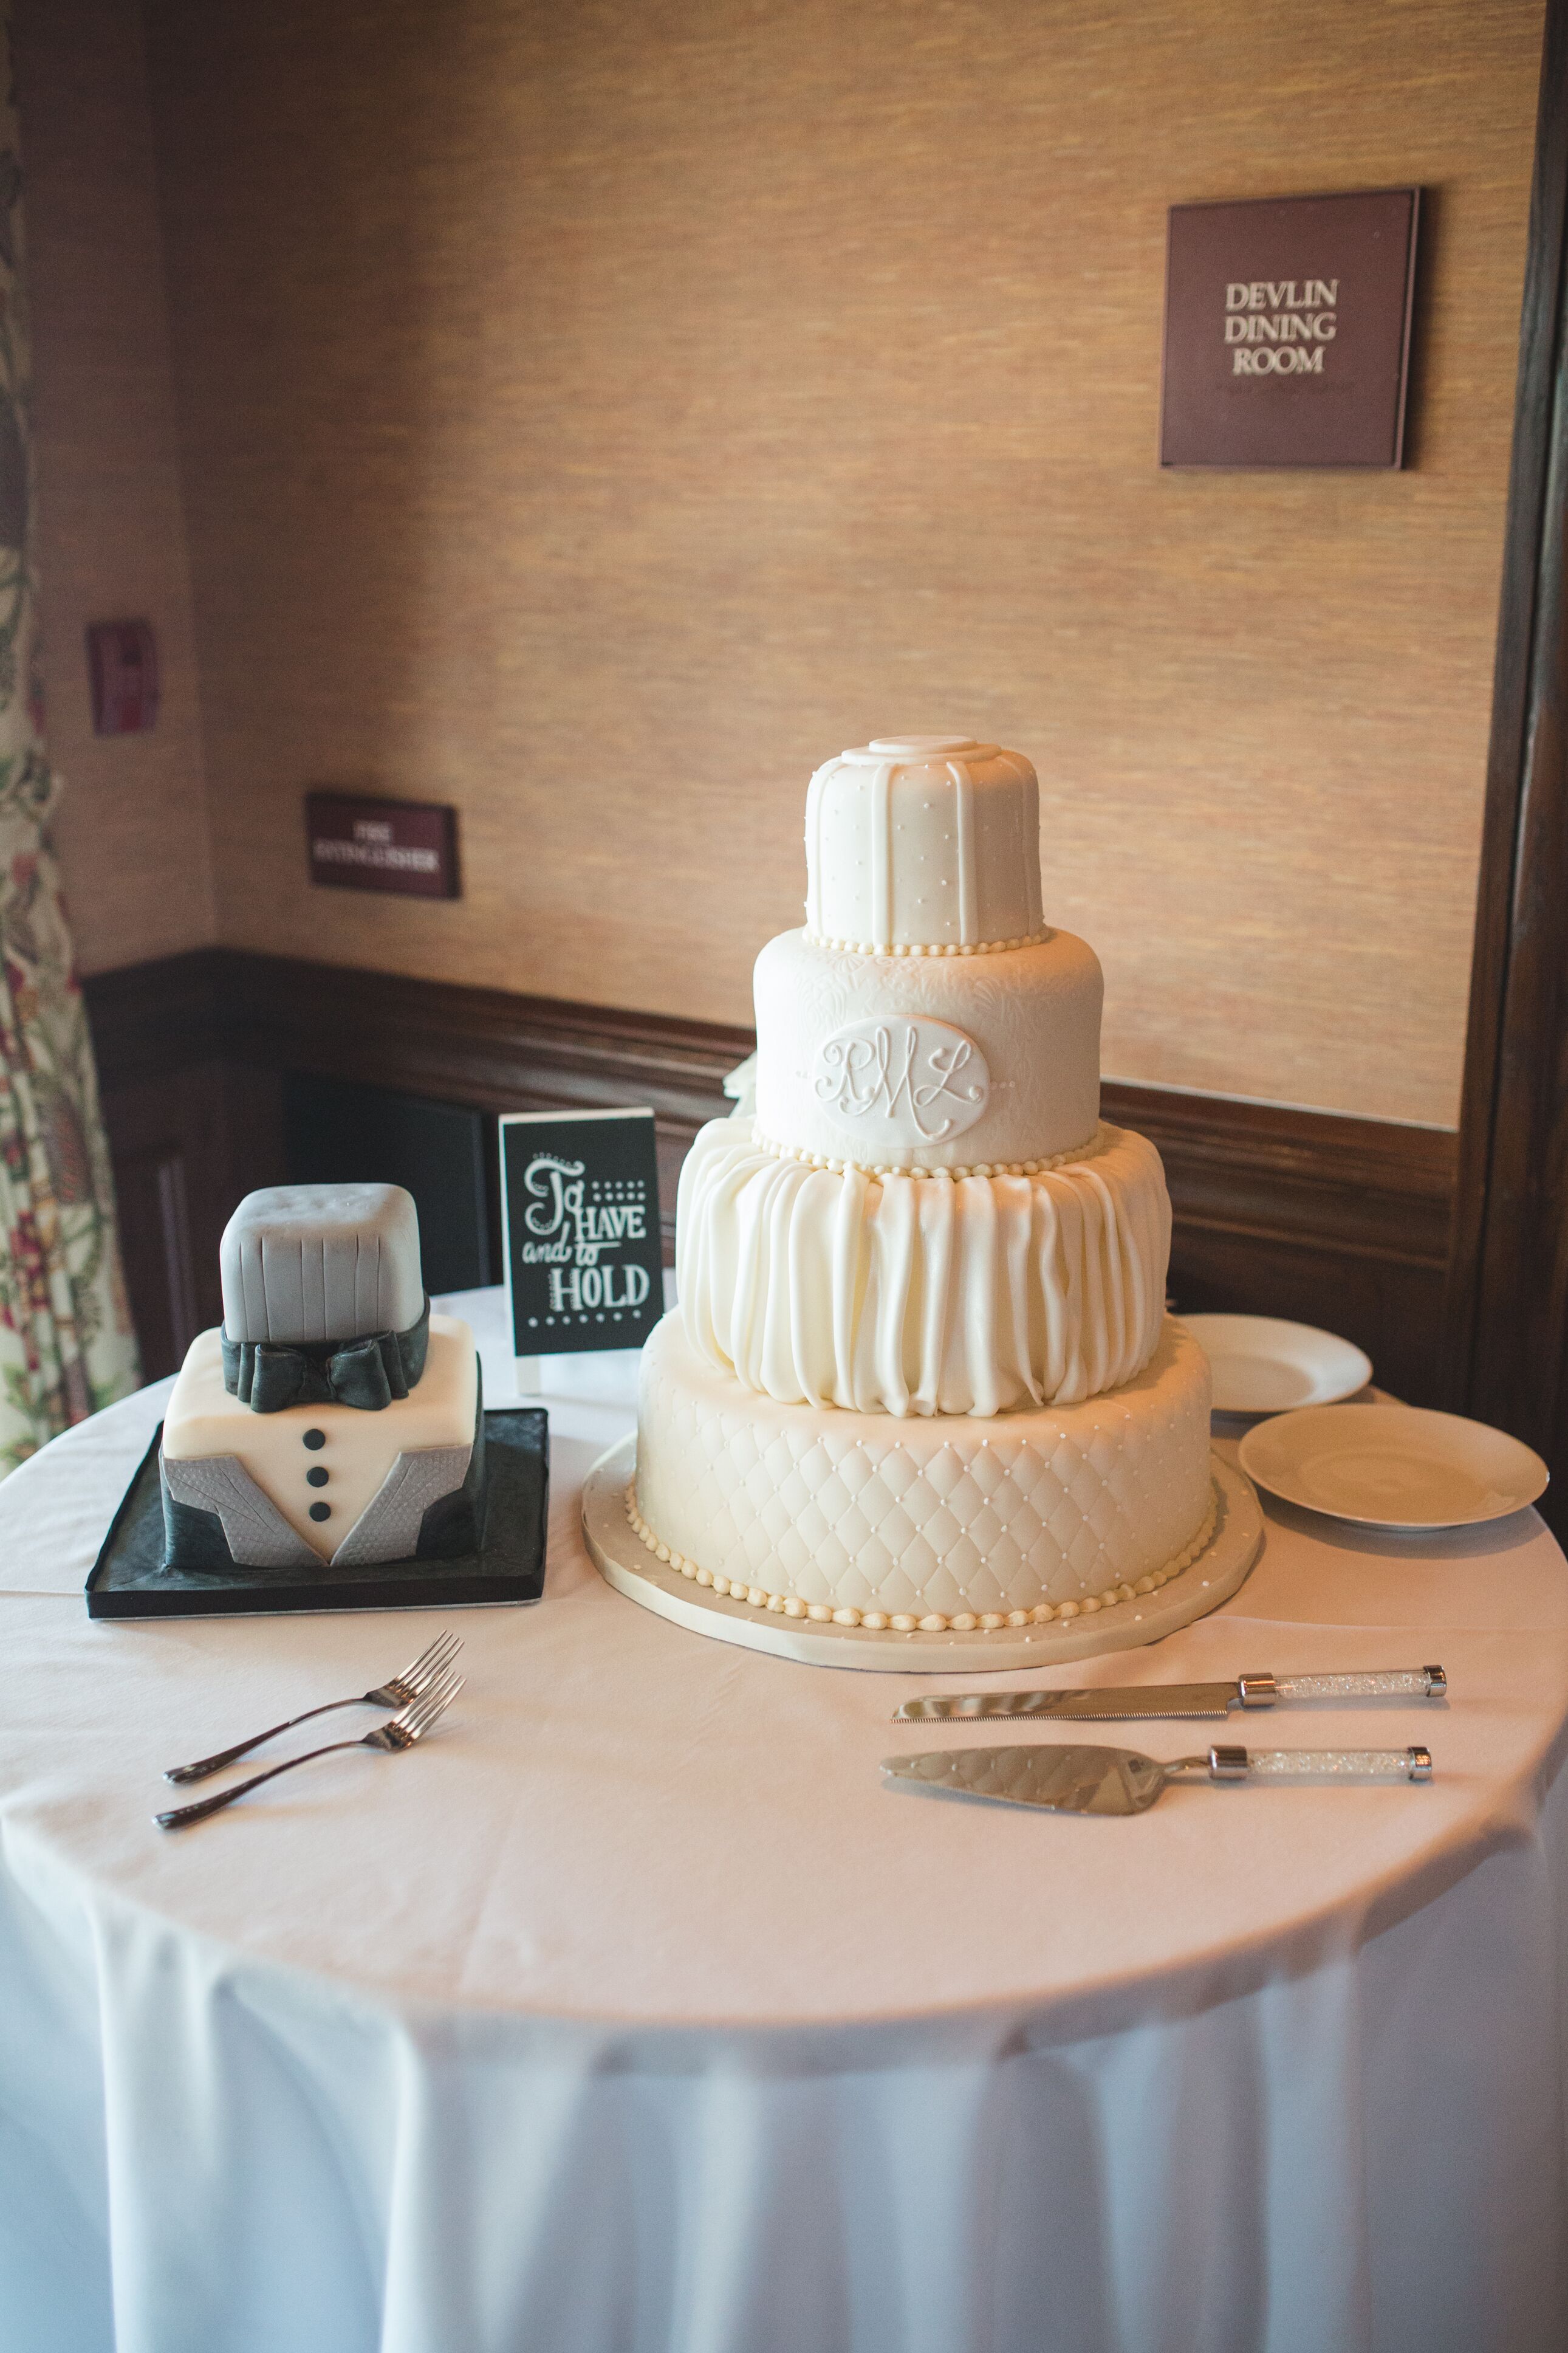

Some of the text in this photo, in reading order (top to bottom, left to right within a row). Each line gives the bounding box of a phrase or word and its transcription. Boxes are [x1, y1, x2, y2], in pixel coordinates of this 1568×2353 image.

[1225, 279, 1339, 311] DEVLIN
[1225, 312, 1336, 343] DINING
[1233, 346, 1326, 375] ROOM
[524, 1155, 585, 1235] To
[575, 1205, 646, 1240] HAVE
[522, 1221, 572, 1263] and
[550, 1265, 650, 1311] HOLD
